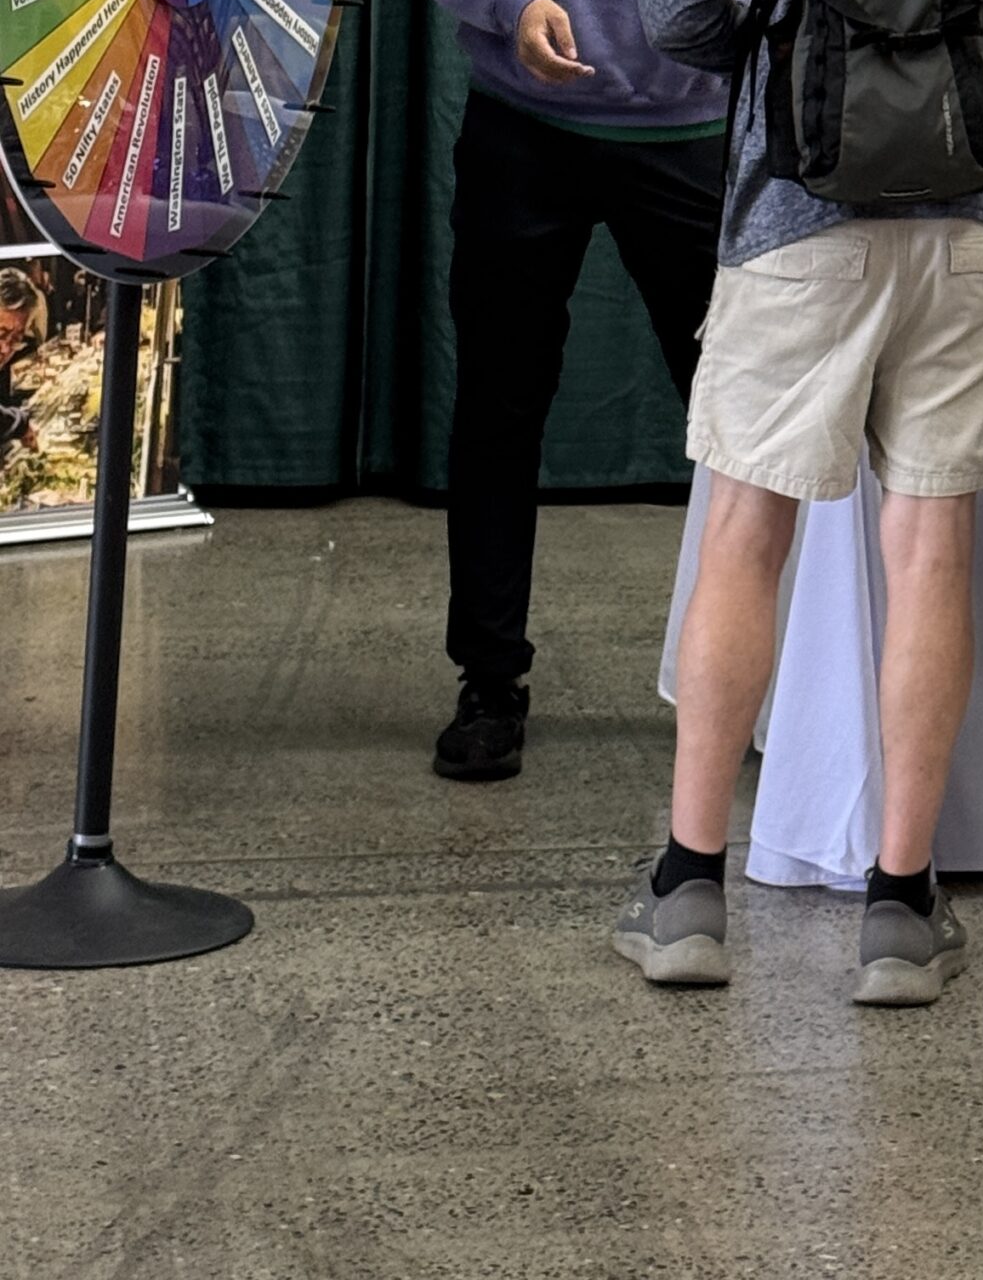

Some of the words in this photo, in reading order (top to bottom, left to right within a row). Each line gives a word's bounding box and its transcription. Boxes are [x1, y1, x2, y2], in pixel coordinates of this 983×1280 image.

[234, 30, 258, 83] America
[291, 18, 318, 52] History
[20, 74, 56, 115] History
[55, 16, 104, 72] Happened
[174, 80, 185, 124] State
[206, 77, 223, 130] People
[253, 83, 263, 98] of
[64, 163, 79, 185] 50
[76, 123, 98, 163] Nifty
[94, 76, 119, 124] States
[258, 99, 280, 141] Voices
[112, 149, 137, 234] American
[132, 58, 158, 149] Revolution
[216, 131, 227, 161] The
[168, 128, 183, 228] Washington
[221, 162, 232, 190] We
